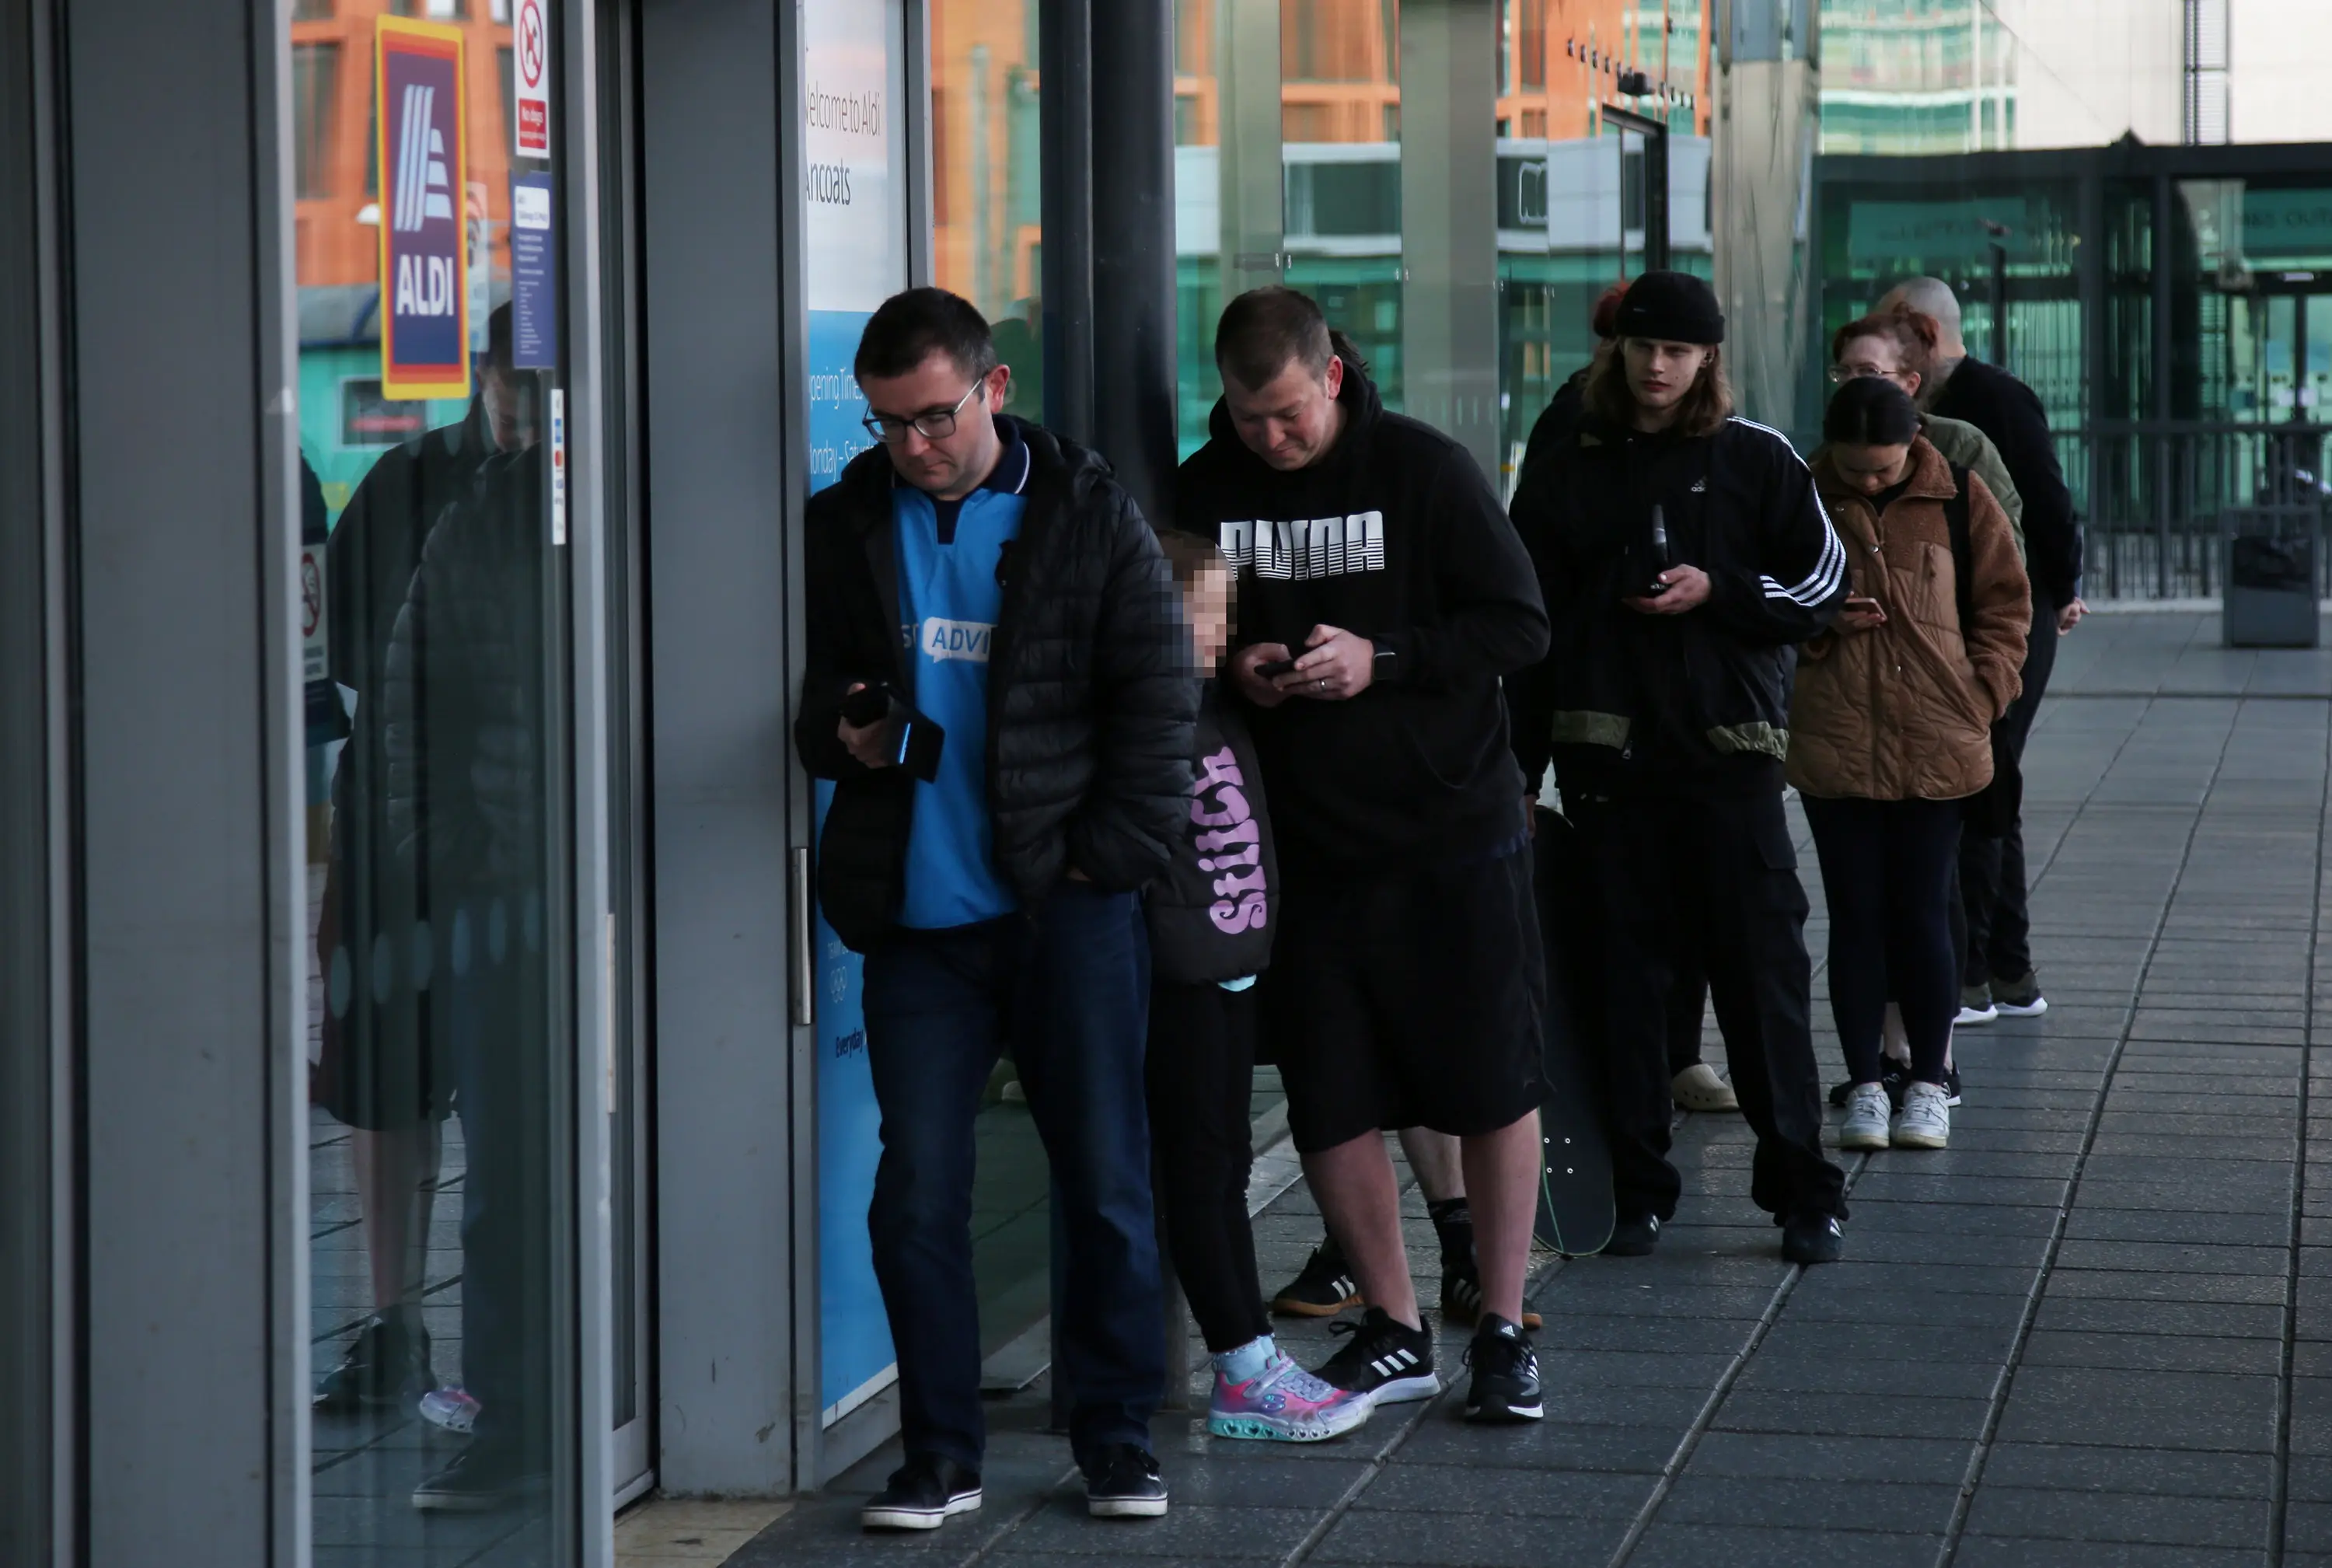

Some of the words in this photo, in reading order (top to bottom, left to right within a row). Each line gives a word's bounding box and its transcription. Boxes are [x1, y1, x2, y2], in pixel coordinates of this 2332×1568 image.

[849, 91, 861, 133] to
[862, 89, 881, 136] Aldi
[396, 254, 454, 316] ALDI
[809, 366, 840, 410] pening
[1220, 510, 1384, 580] PUMA
[900, 623, 920, 648] ST
[931, 627, 990, 655] ADVI
[1190, 746, 1267, 934] Stitch
